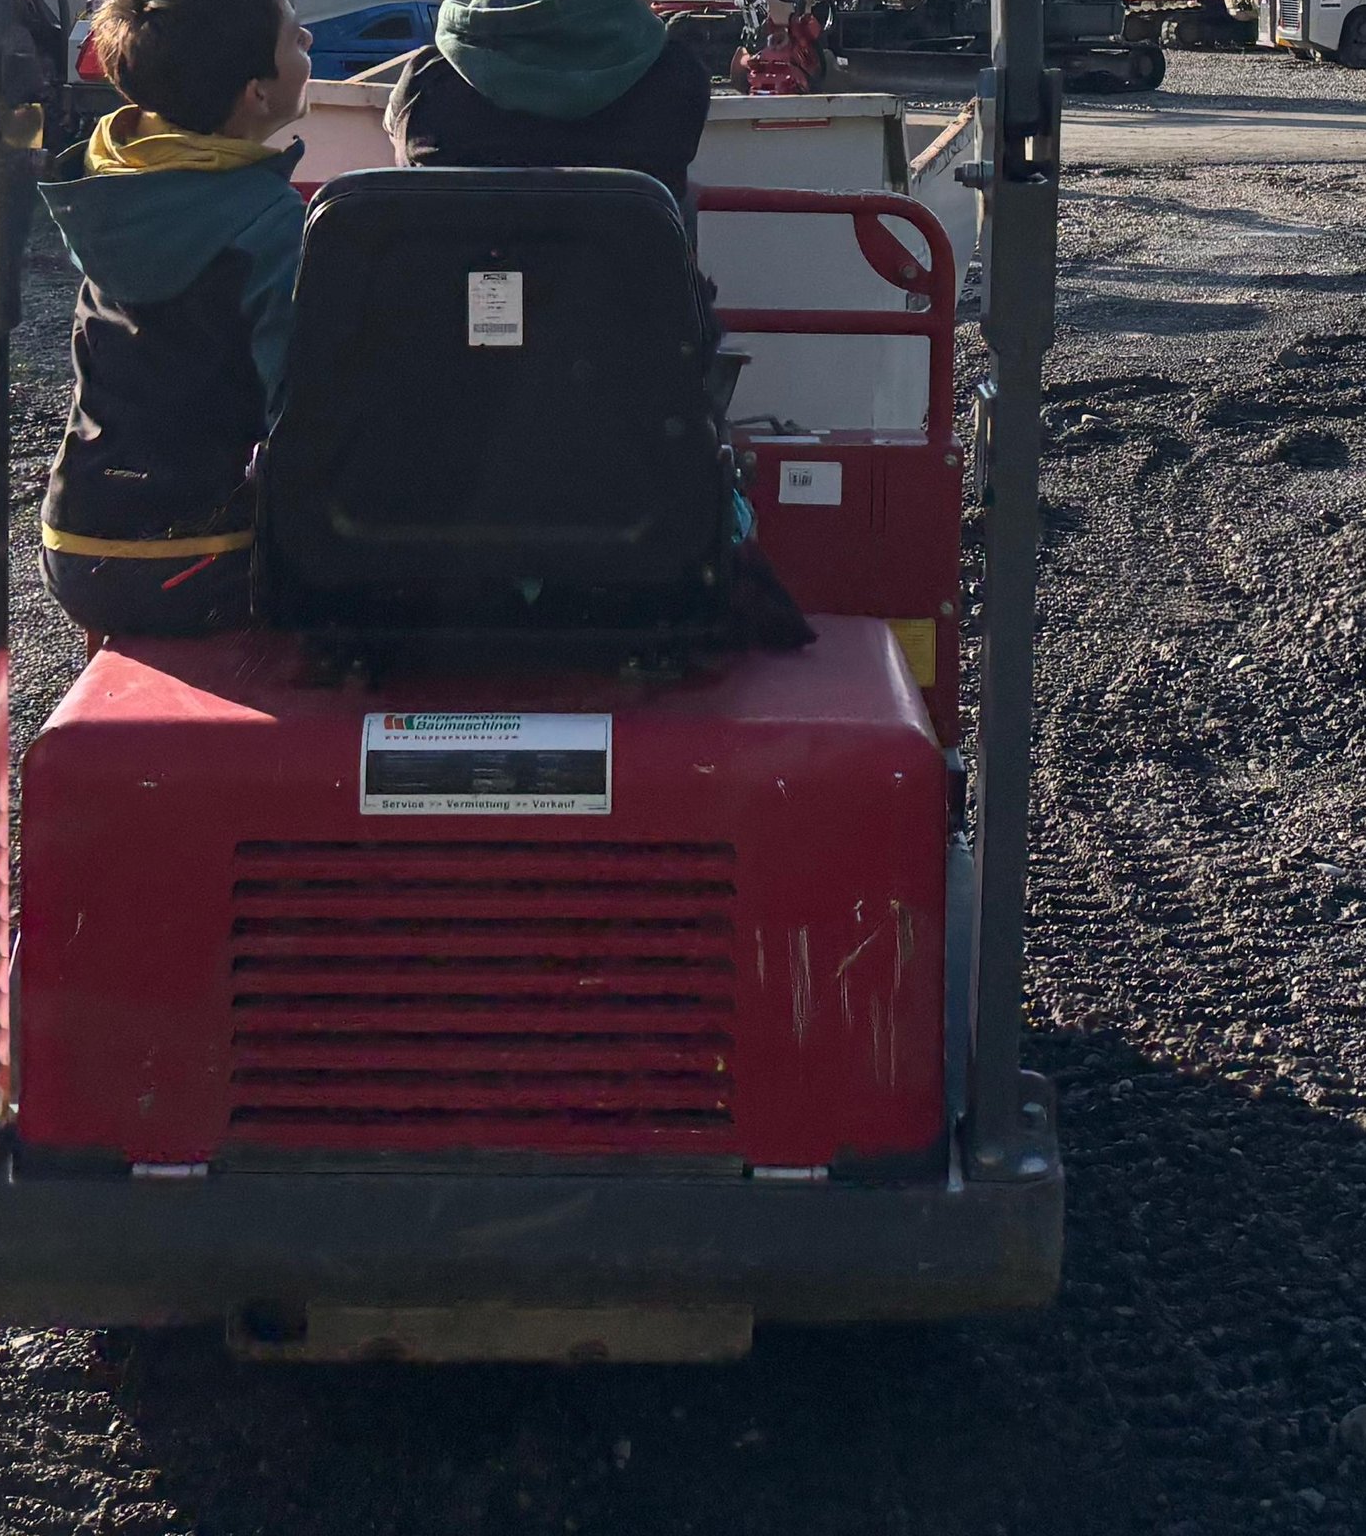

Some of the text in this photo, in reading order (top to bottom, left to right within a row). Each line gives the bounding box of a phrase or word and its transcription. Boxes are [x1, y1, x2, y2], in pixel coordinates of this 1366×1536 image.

[416, 720, 521, 731] Baumaschinen
[382, 799, 575, 811] Service Vermietung Verkauf
